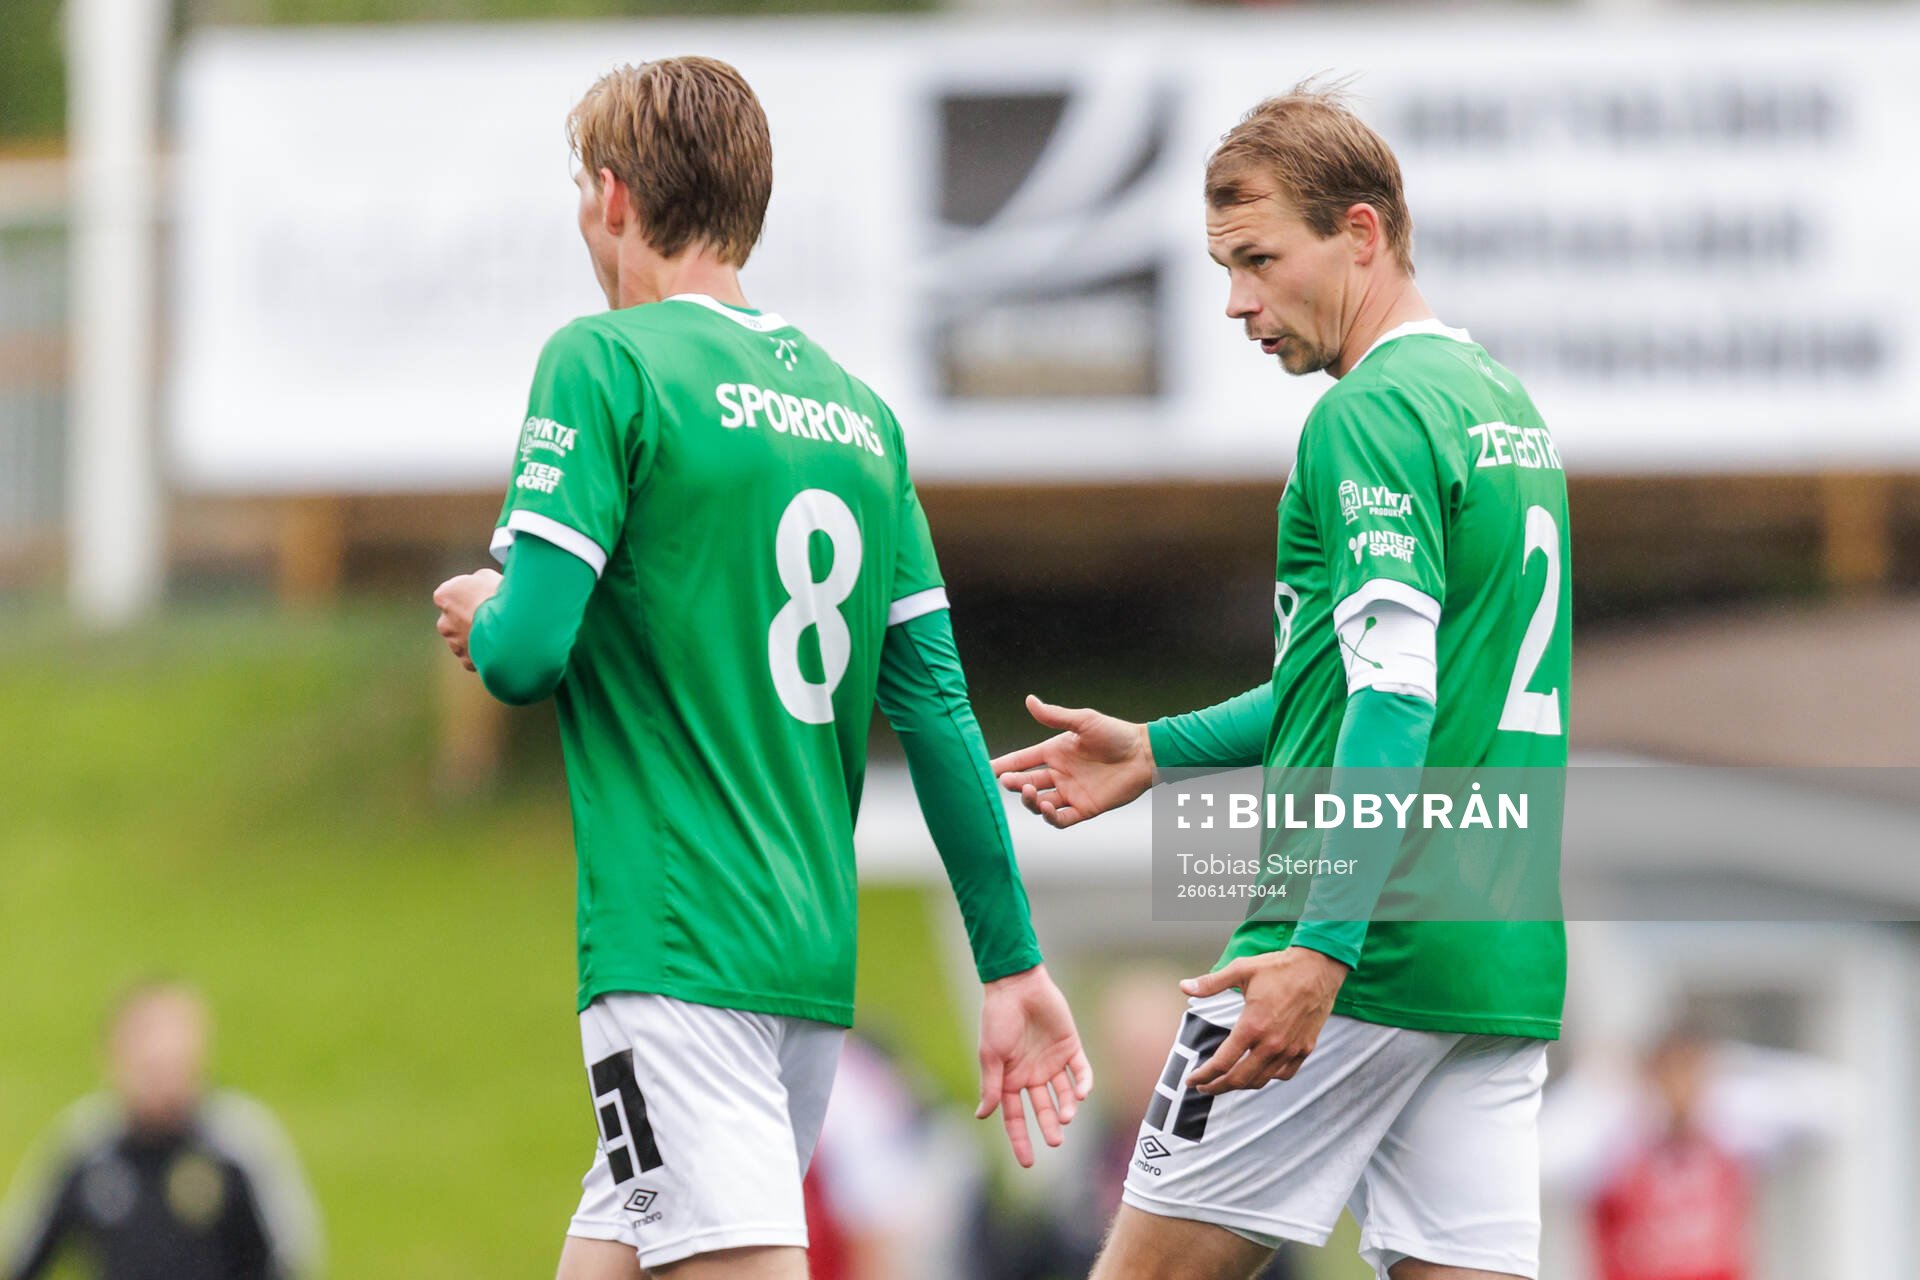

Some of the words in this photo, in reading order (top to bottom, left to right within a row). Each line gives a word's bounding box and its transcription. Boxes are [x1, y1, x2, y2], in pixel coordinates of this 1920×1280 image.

[715, 383, 884, 457] SPORRONG
[1369, 530, 1416, 550] INTER
[1369, 543, 1414, 563] SPORT
[768, 488, 862, 724] 8
[1497, 505, 1562, 725] 2
[1135, 1159, 1162, 1176] mbro
